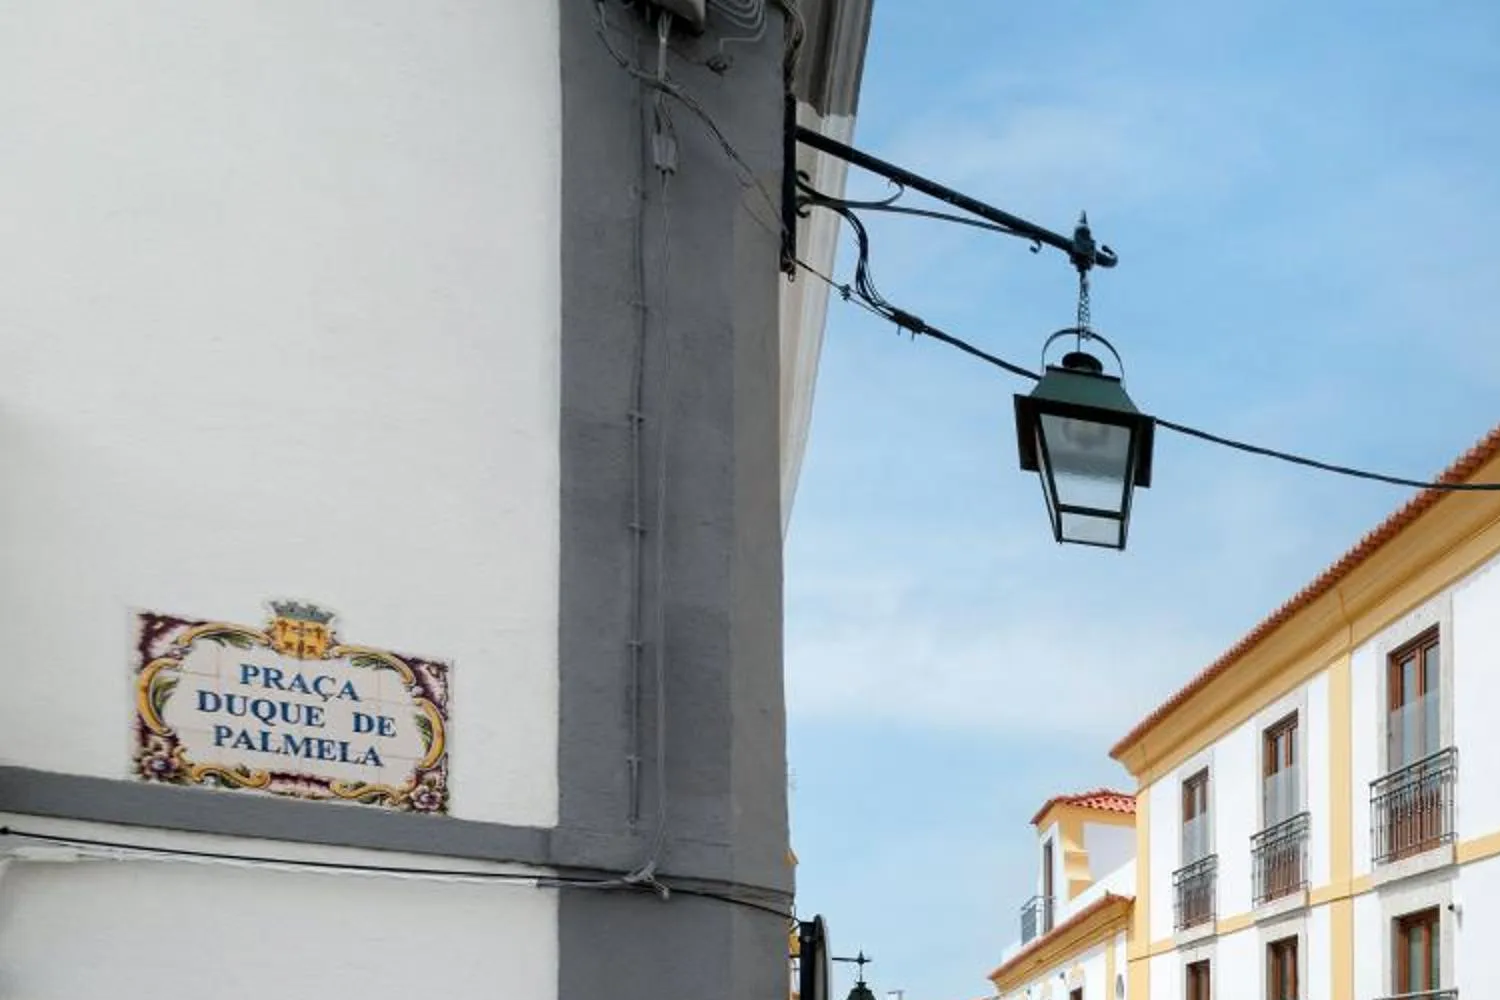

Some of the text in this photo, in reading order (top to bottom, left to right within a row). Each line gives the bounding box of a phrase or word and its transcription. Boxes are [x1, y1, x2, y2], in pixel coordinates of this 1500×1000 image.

[239, 663, 363, 702] PRAÇA
[195, 689, 398, 738] DUQUE DE
[213, 725, 384, 768] PALMELA
